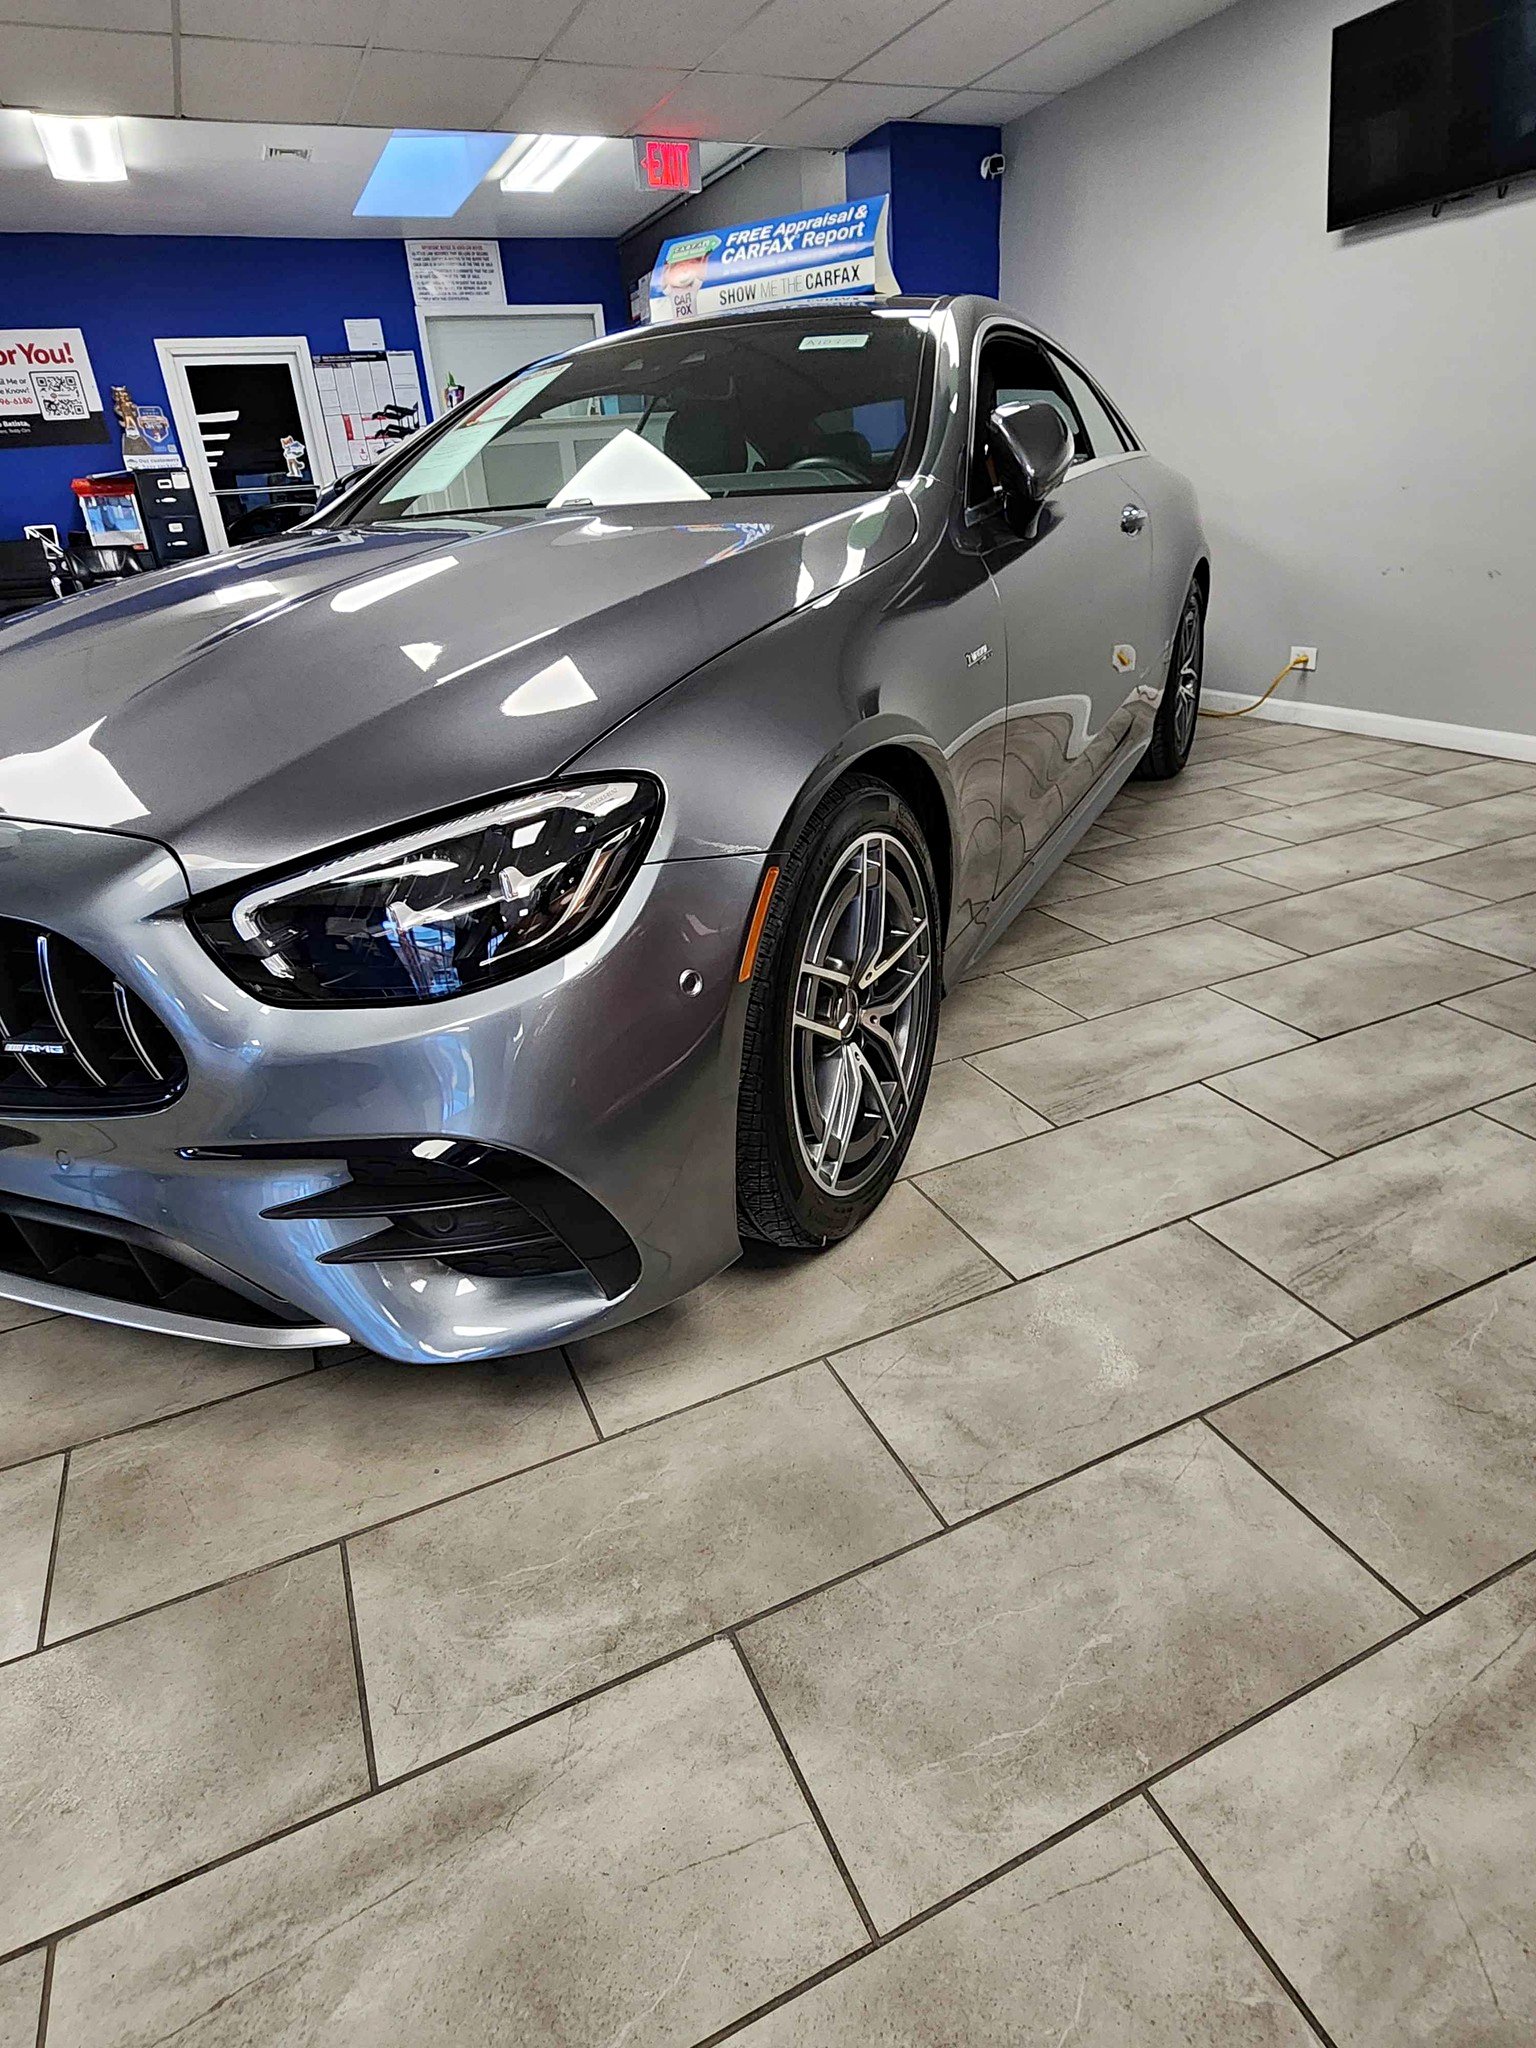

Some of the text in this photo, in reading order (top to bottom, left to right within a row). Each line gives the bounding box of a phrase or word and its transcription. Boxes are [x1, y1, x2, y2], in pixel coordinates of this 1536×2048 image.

[646, 142, 689, 187] EXIT
[725, 204, 868, 247] FREE Appraisal &
[721, 221, 865, 264] CARFAX Report
[719, 283, 757, 306] SHOW
[760, 279, 778, 298] ME
[781, 274, 803, 295] THE
[805, 264, 861, 290] CARFAX
[674, 292, 692, 306] CAR
[676, 303, 693, 318] FOX
[0, 341, 75, 366] or You!
[0, 397, 33, 405] 96-6180
[5, 387, 30, 395] Know!
[23, 1044, 64, 1053] AMG
